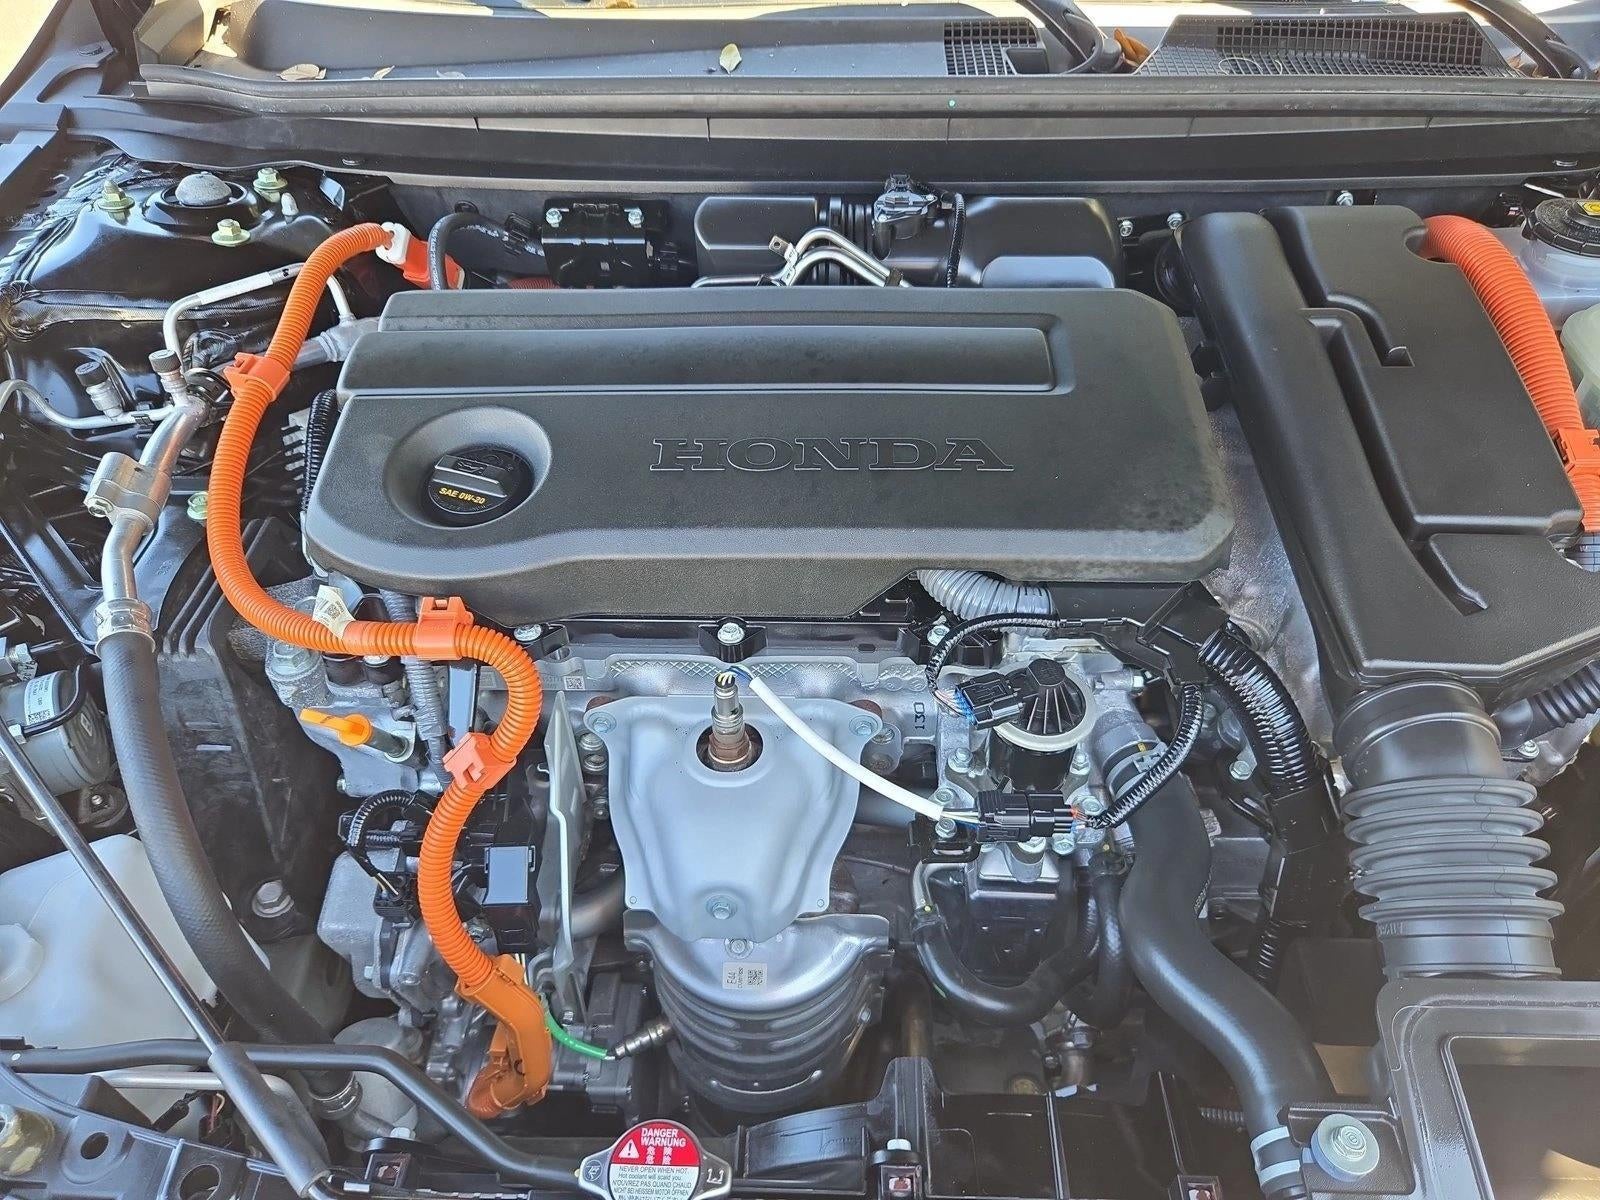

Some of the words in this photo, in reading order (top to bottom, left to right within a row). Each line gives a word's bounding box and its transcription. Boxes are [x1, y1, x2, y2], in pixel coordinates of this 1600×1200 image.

[650, 437, 1014, 471] HONDA
[439, 487, 459, 498] SAE
[458, 492, 486, 505] 0W-20
[641, 1127, 679, 1137] DANGER
[640, 1137, 687, 1147] WARNUNG
[619, 1165, 639, 1173] NEVER
